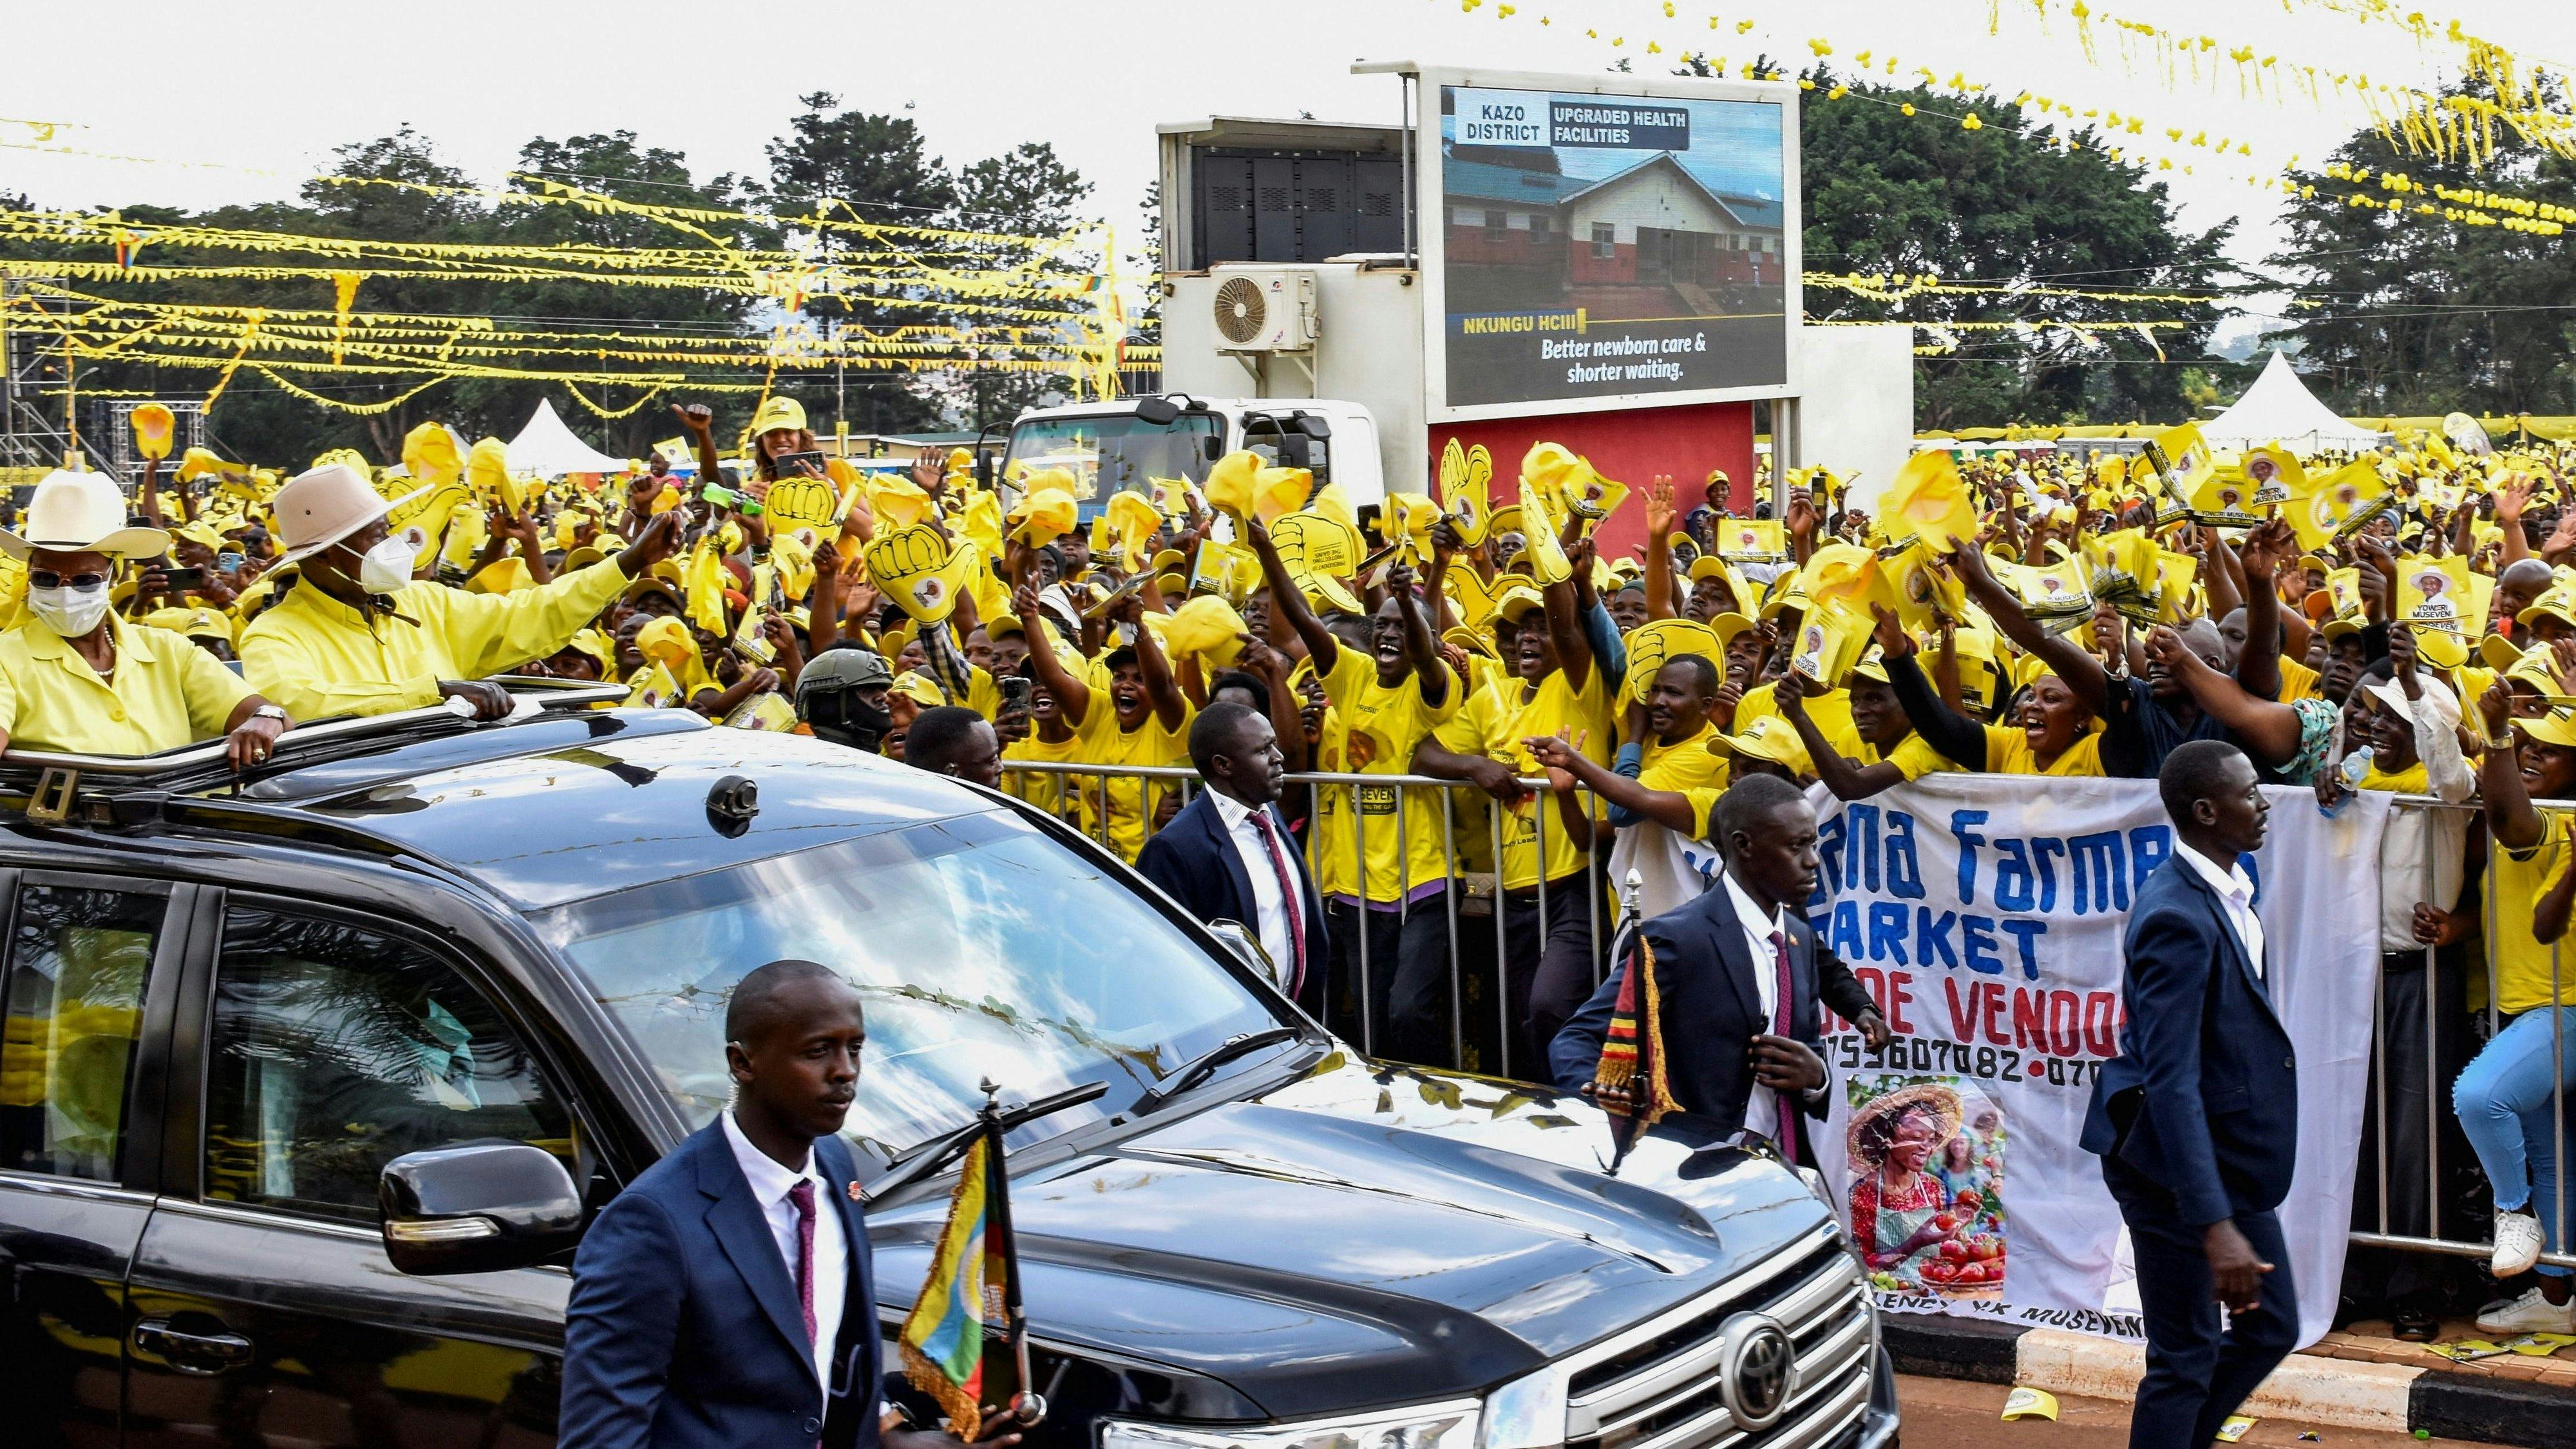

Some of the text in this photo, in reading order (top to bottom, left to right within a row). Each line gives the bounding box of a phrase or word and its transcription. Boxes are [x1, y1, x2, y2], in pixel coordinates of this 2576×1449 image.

[1482, 104, 1525, 121] KAZO
[1554, 107, 1686, 128] UPGRADED HEALTH
[1466, 123, 1540, 141] DISTRICT
[1554, 127, 1630, 144] FACILITIES
[1463, 314, 1577, 334] NKUNGU HCIII
[1541, 332, 1707, 359] Better newborn care &
[1567, 359, 1683, 383] shorter waiting.
[2252, 493, 2287, 505] MUSEVENI
[2255, 487, 2282, 497] YOWERI
[1312, 554, 1345, 564] PROTECTING
[1318, 561, 1346, 571] PRESIDENT
[1944, 976, 2126, 1057] VENDO
[2020, 1307, 2145, 1338] MUSEVEN
